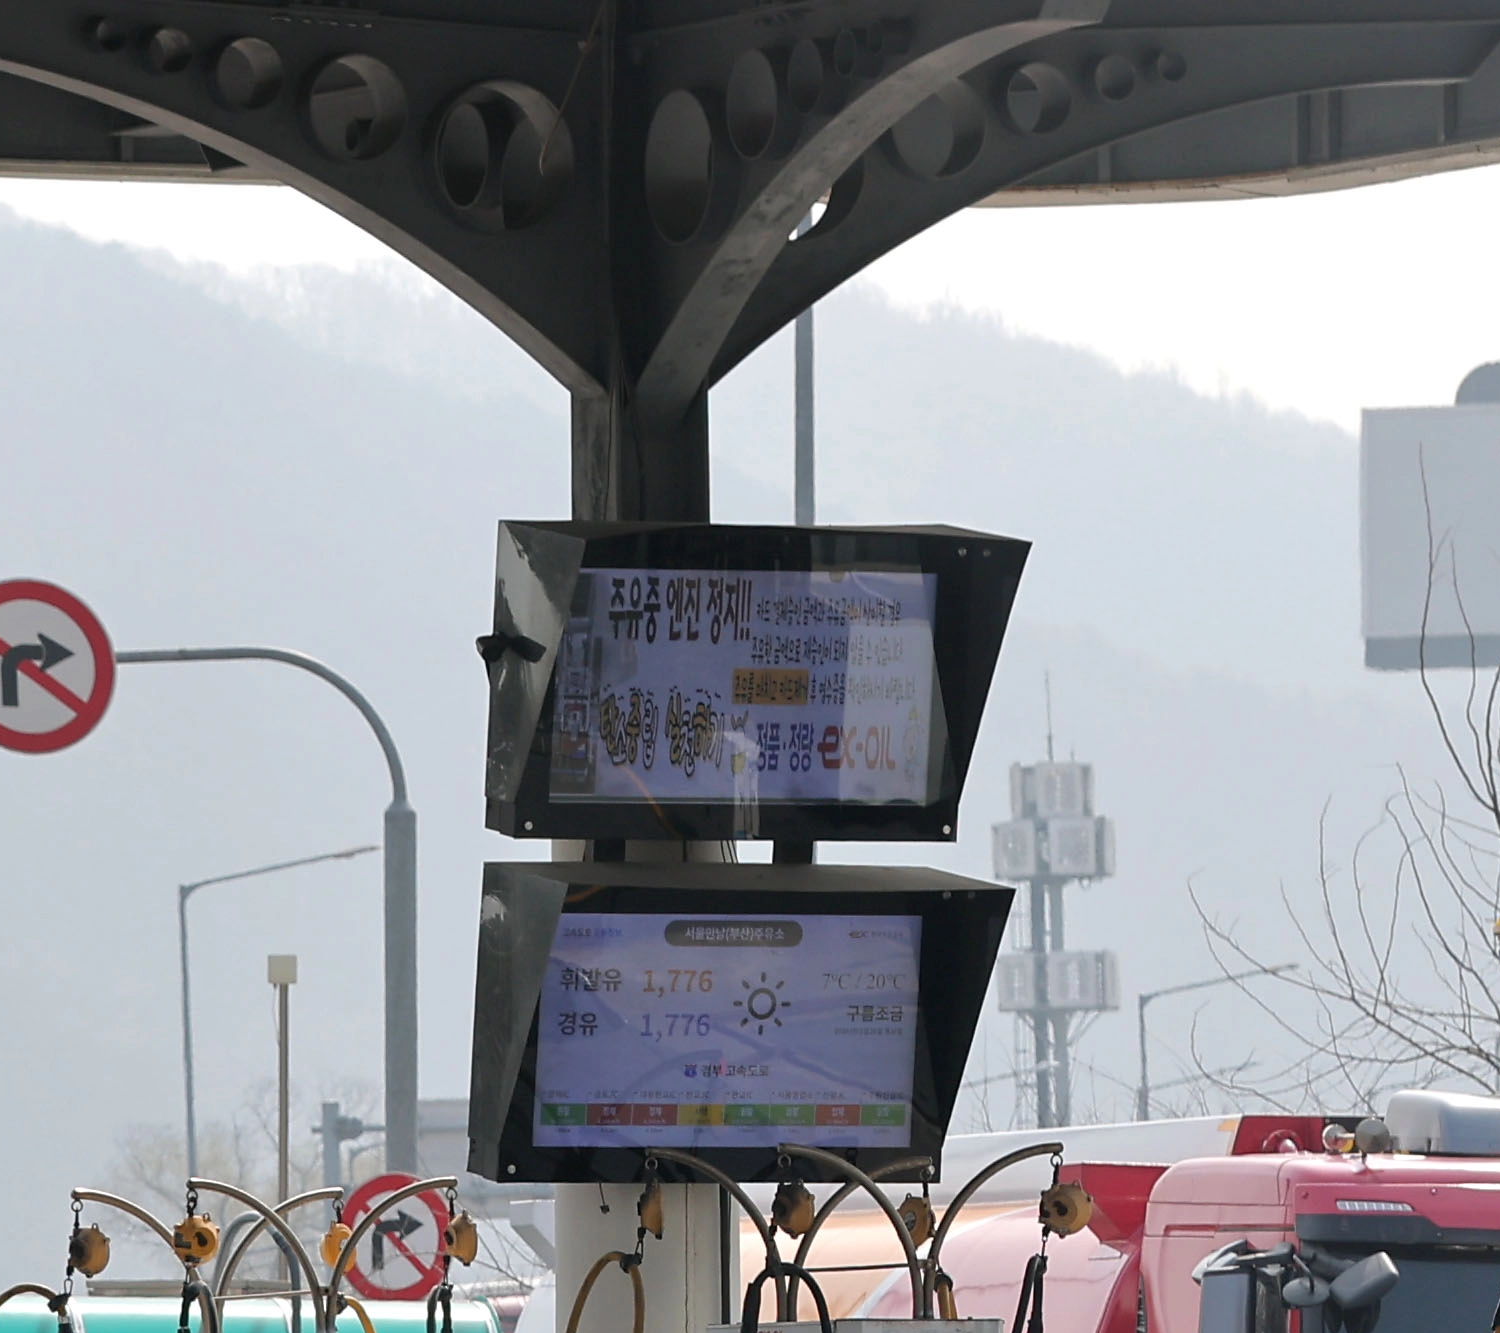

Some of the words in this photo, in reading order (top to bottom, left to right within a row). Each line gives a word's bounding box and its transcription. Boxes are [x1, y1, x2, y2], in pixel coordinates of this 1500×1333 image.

[608, 577, 661, 645] 주유중
[666, 577, 701, 642] 엔진
[560, 967, 623, 993] 휘발유
[642, 968, 714, 998] 1,776
[557, 1012, 598, 1037] 경유
[639, 1012, 711, 1043] 1,776
[846, 1004, 904, 1022] 구름조금
